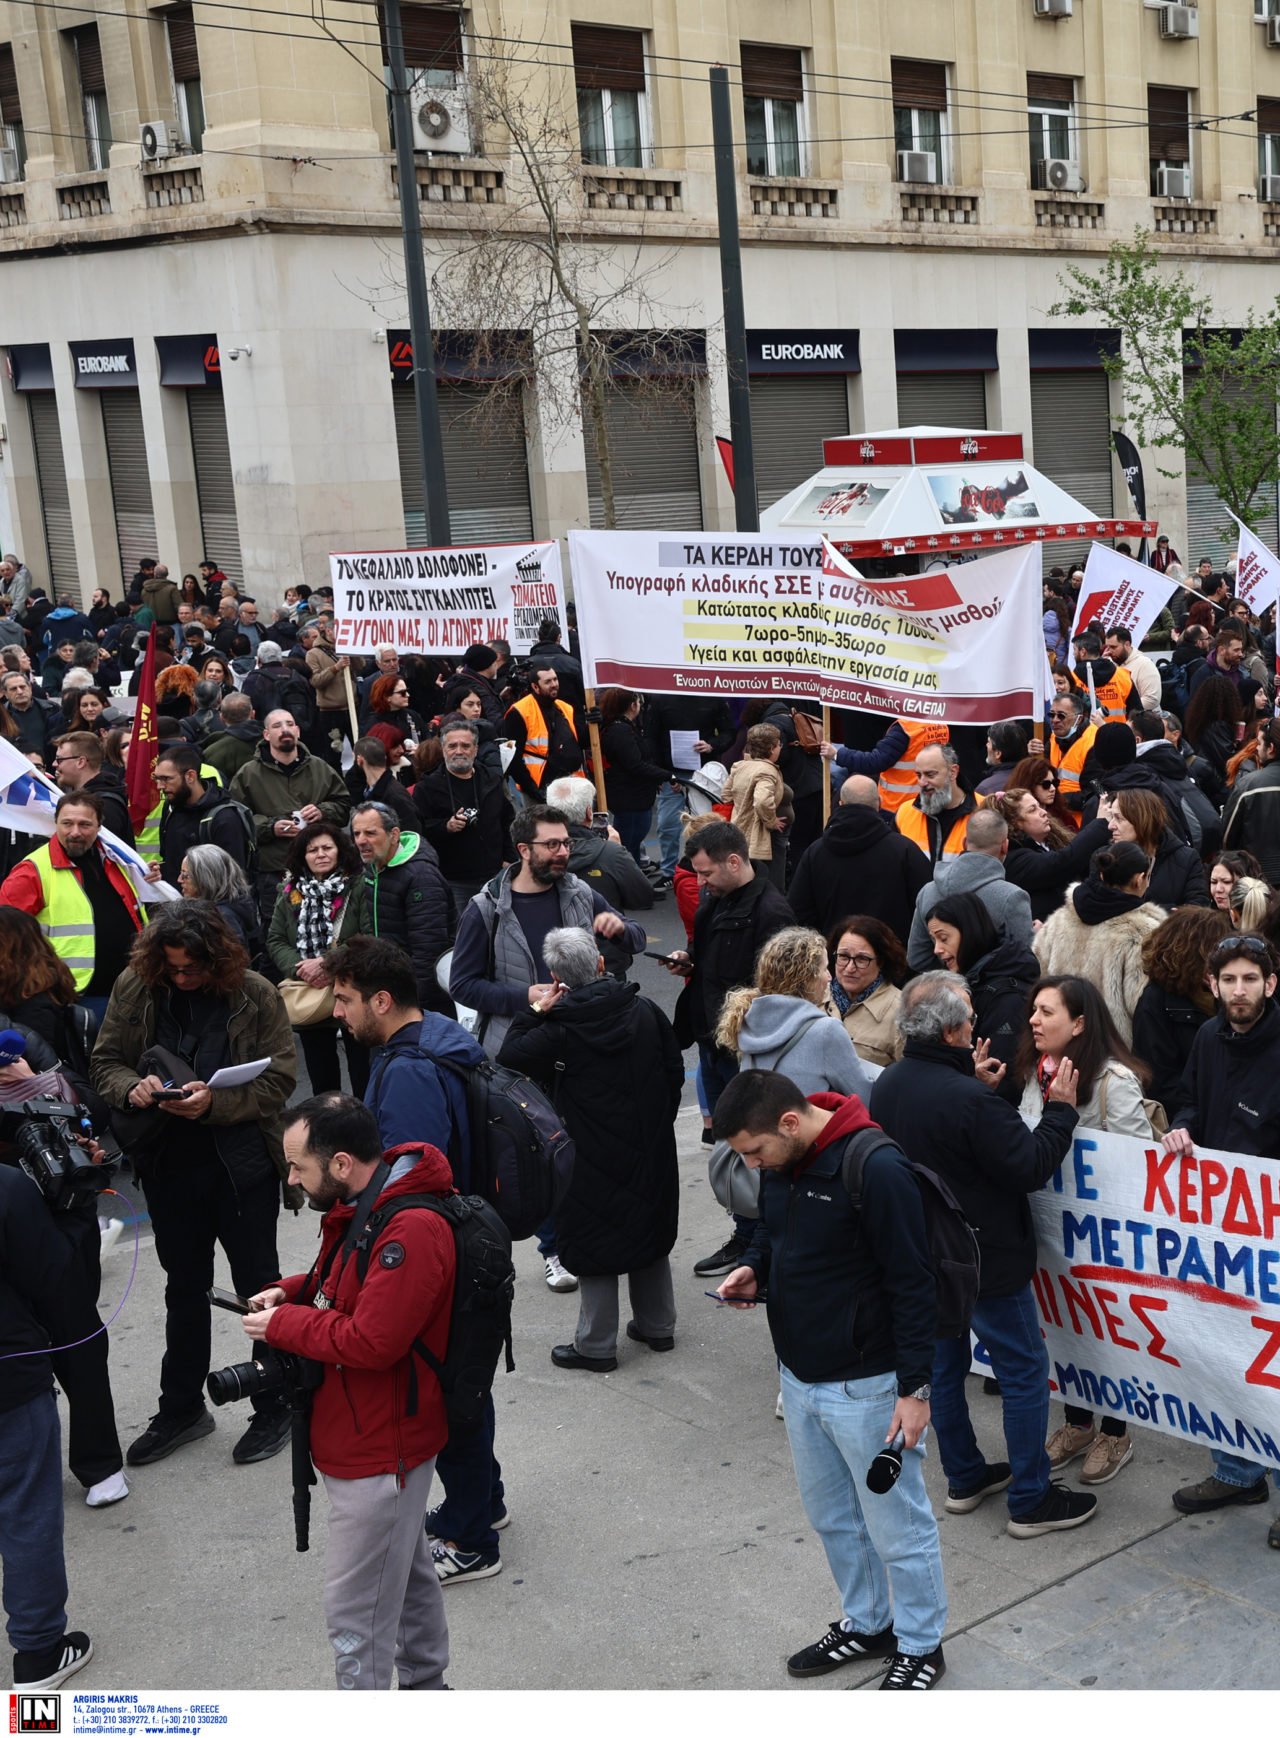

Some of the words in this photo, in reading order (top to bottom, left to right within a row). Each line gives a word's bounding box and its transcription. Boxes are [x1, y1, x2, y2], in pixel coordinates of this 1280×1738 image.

[78, 355, 130, 373] EUROBANK
[762, 343, 844, 360] EUROBANK
[353, 557, 414, 580] ΚΕΦΑΛΑΙΟ
[417, 553, 487, 579] ΔΟΛΟΦΟΝΕΙ
[684, 546, 705, 565] ΤΑ
[712, 547, 773, 566] ΚΕΡΔΗ
[779, 548, 823, 567] ΤΟΥΣ
[511, 583, 558, 607] ΣΩΜΑΤΕΙΟ
[607, 571, 686, 596] Υπογραφή
[692, 574, 769, 598] κλαδικής
[774, 575, 812, 595] ΣΣΕ
[346, 590, 364, 612] ΤΟ
[369, 590, 412, 611] ΚΡΑΤΟΣ
[415, 587, 497, 611] ΣΥΓΚΑΛΥΠΤΕΙ
[697, 600, 777, 621] Κατώτατος
[834, 611, 890, 635] μισθός
[428, 618, 438, 647] ΟΙ
[689, 645, 727, 665] Υγεία
[732, 648, 757, 663] και
[763, 646, 822, 667] ασφάλει
[849, 659, 909, 684] εργασία
[912, 671, 937, 690] μας
[673, 674, 711, 689] Ένωση
[713, 676, 768, 694] Λογιστών
[903, 697, 946, 717] (ΕΛΕΠΑ)
